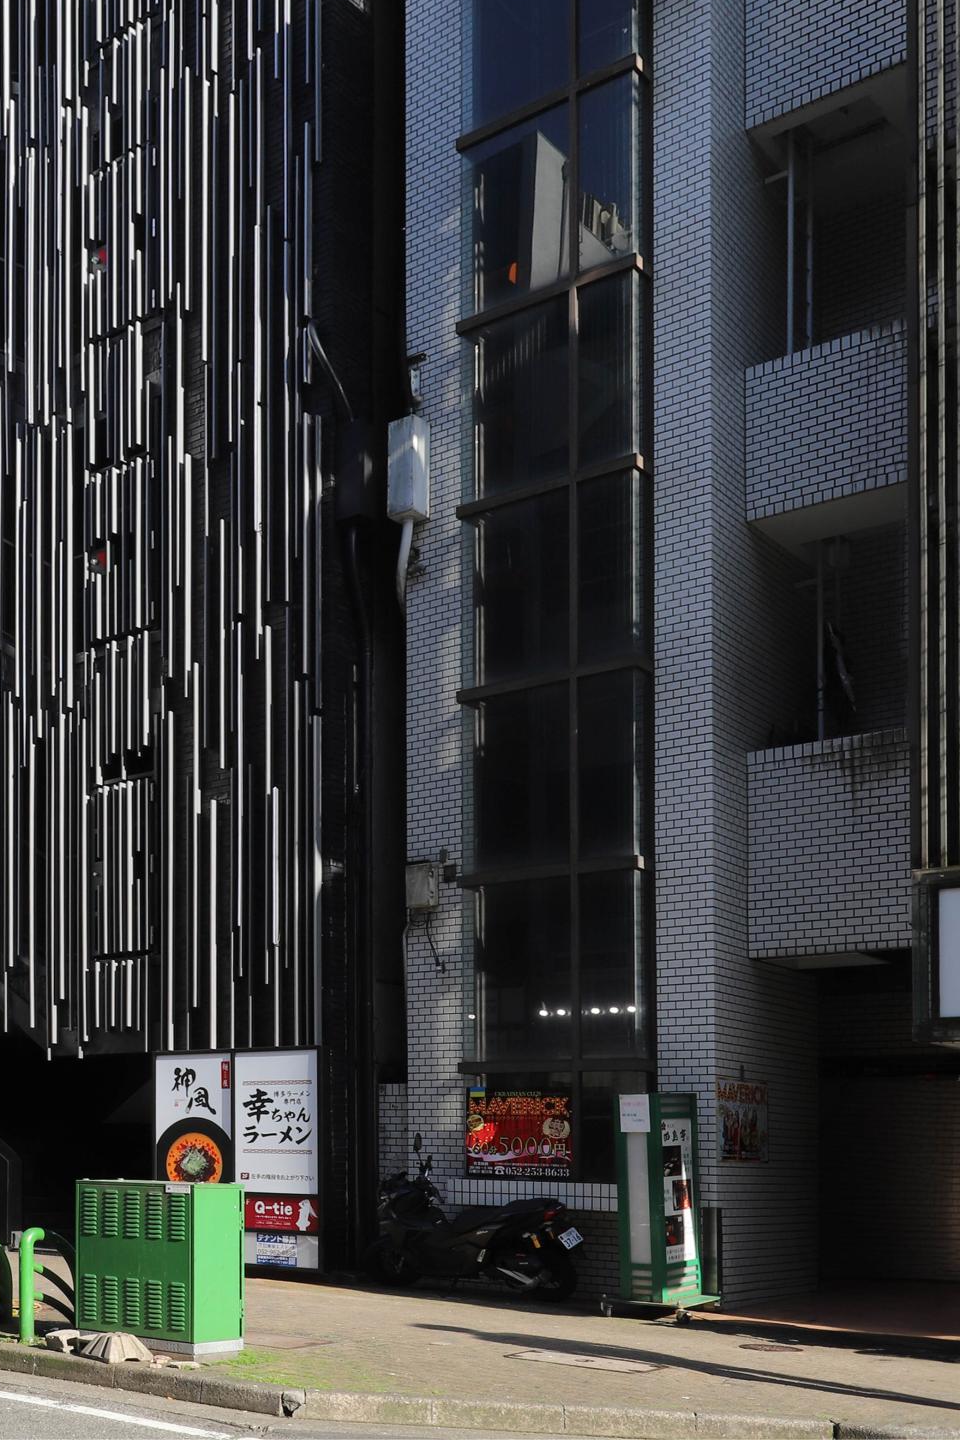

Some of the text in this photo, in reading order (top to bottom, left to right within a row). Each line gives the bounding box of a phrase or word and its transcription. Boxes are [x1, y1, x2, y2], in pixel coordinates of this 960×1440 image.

[242, 1088, 311, 1124] 幸ちゃん
[468, 1096, 569, 1116] MAVERICK
[242, 1125, 313, 1145] ラーメン
[499, 1136, 566, 1157] 5000円
[505, 1167, 570, 1177] 052-253-8633
[254, 1200, 293, 1216] Q-tie
